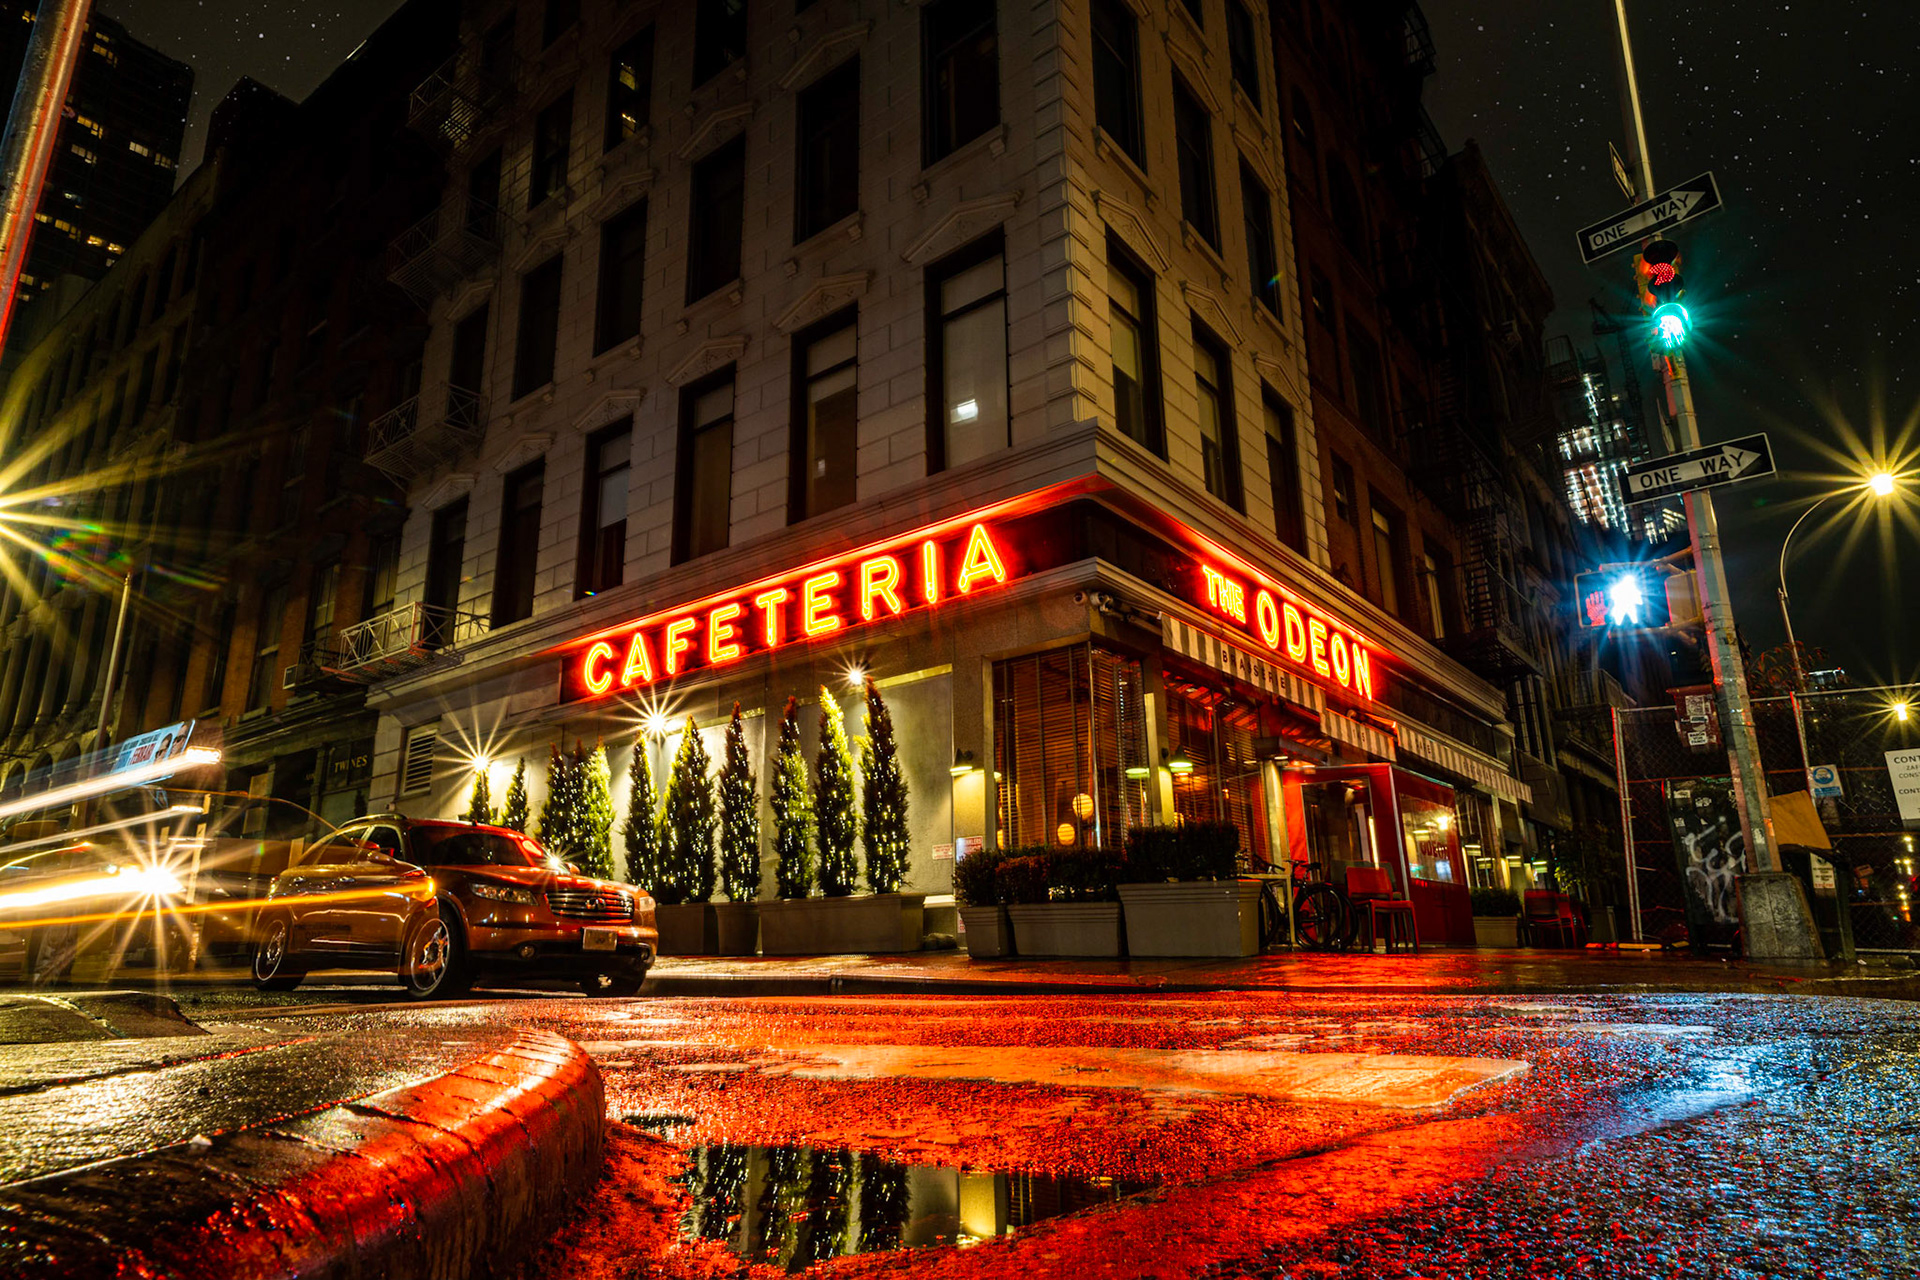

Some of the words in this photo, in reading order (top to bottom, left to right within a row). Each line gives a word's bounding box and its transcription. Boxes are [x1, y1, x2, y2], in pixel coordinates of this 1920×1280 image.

[1593, 222, 1629, 247] ONE
[1652, 193, 1690, 221] WAY
[1640, 467, 1682, 489] ONE
[1700, 451, 1745, 475] WAY
[583, 523, 1007, 696] CAFETERIA
[1202, 564, 1247, 625] THE
[1256, 588, 1373, 701] ODEON
[1222, 650, 1286, 689] BRASSERIE
